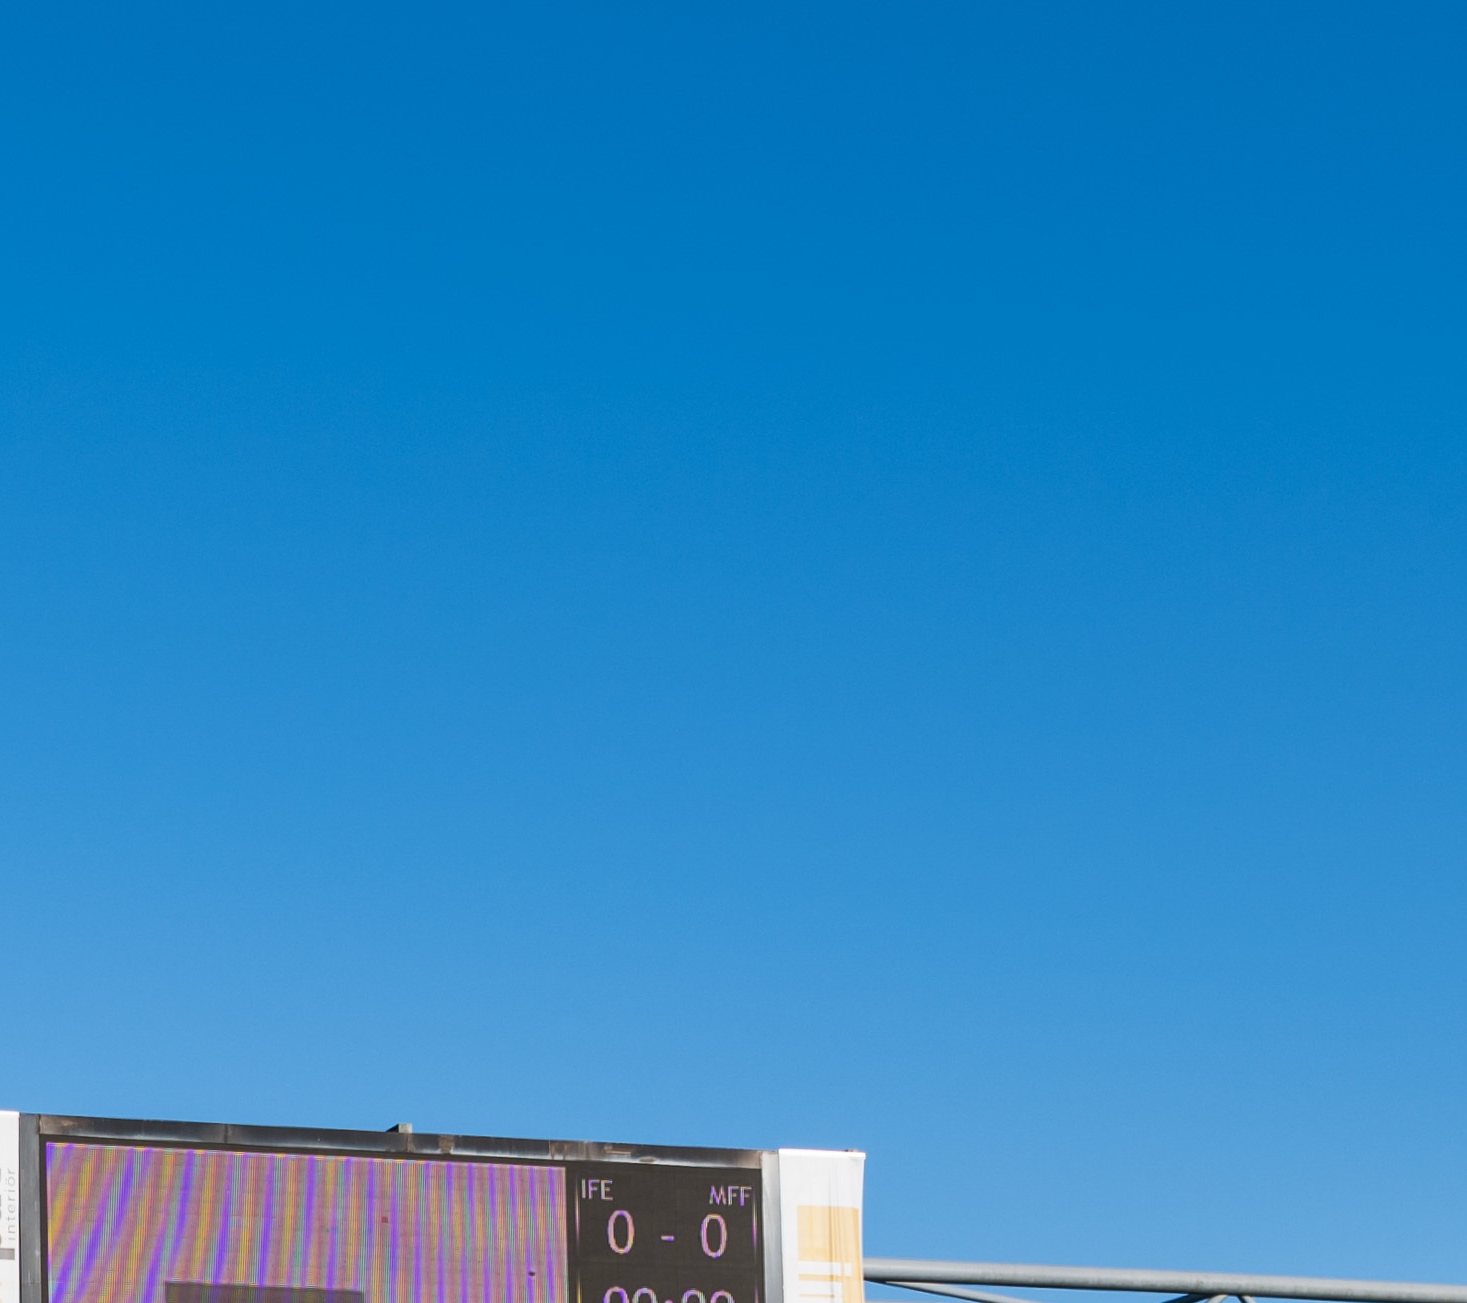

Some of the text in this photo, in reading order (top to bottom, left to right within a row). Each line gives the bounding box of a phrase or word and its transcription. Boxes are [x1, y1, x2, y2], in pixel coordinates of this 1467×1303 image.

[581, 1179, 613, 1200] IFE
[709, 1186, 752, 1206] MFF
[608, 1210, 634, 1254] 0
[701, 1214, 727, 1258] 0
